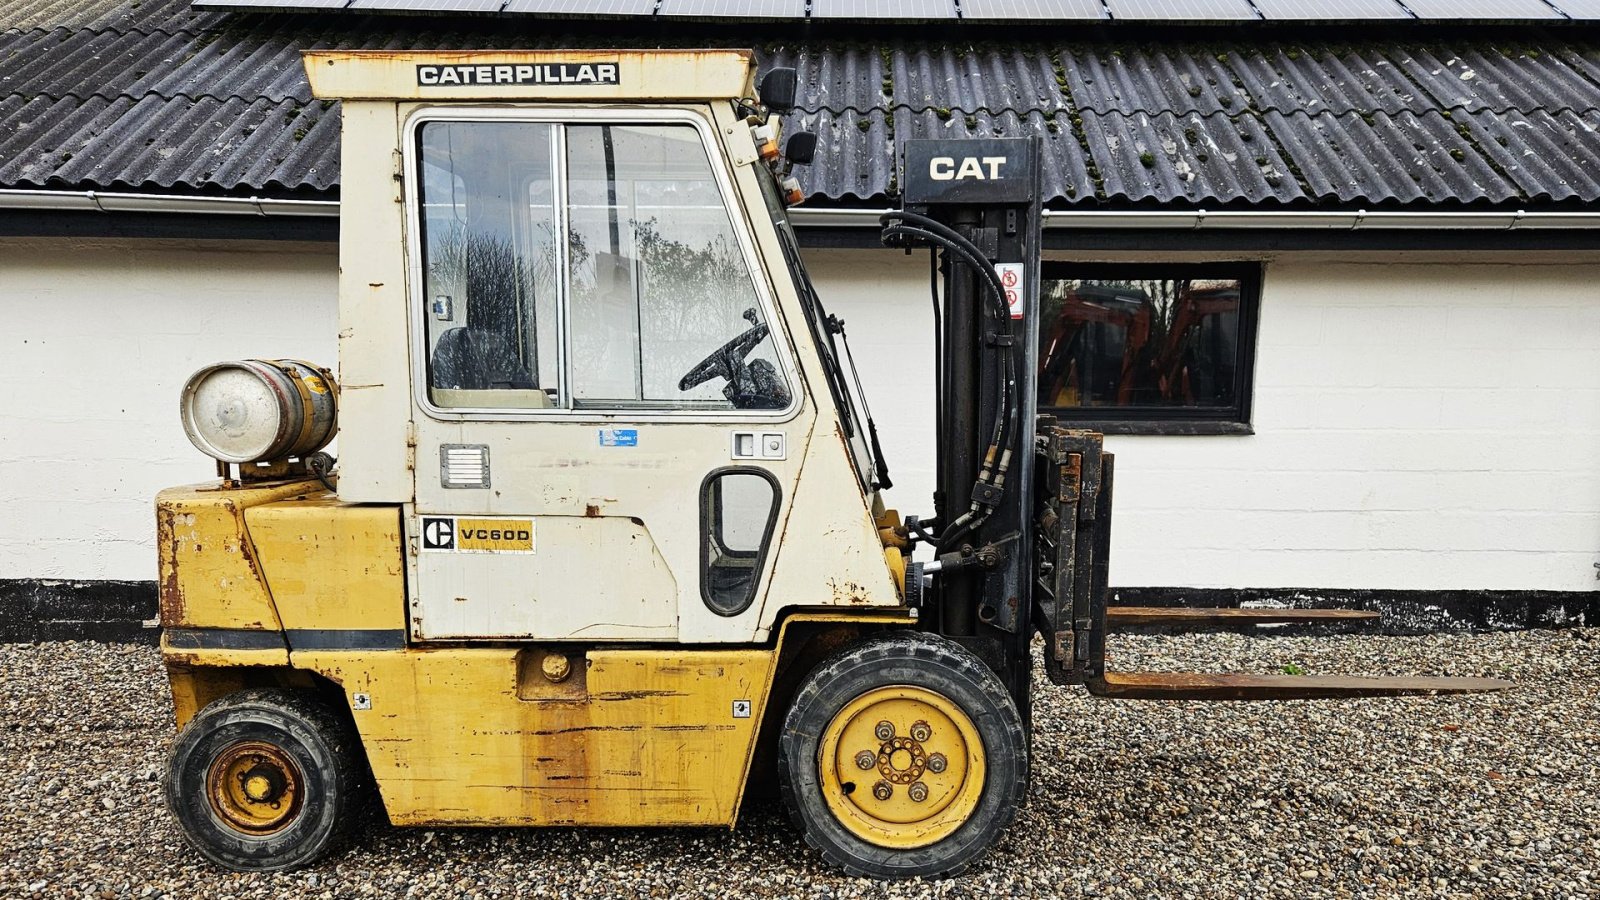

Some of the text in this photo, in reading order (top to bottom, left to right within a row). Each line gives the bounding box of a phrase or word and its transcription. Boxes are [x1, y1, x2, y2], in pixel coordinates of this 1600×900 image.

[419, 64, 616, 84] CATERPILLAR
[929, 156, 1007, 181] CAT
[461, 529, 530, 541] VC60D
